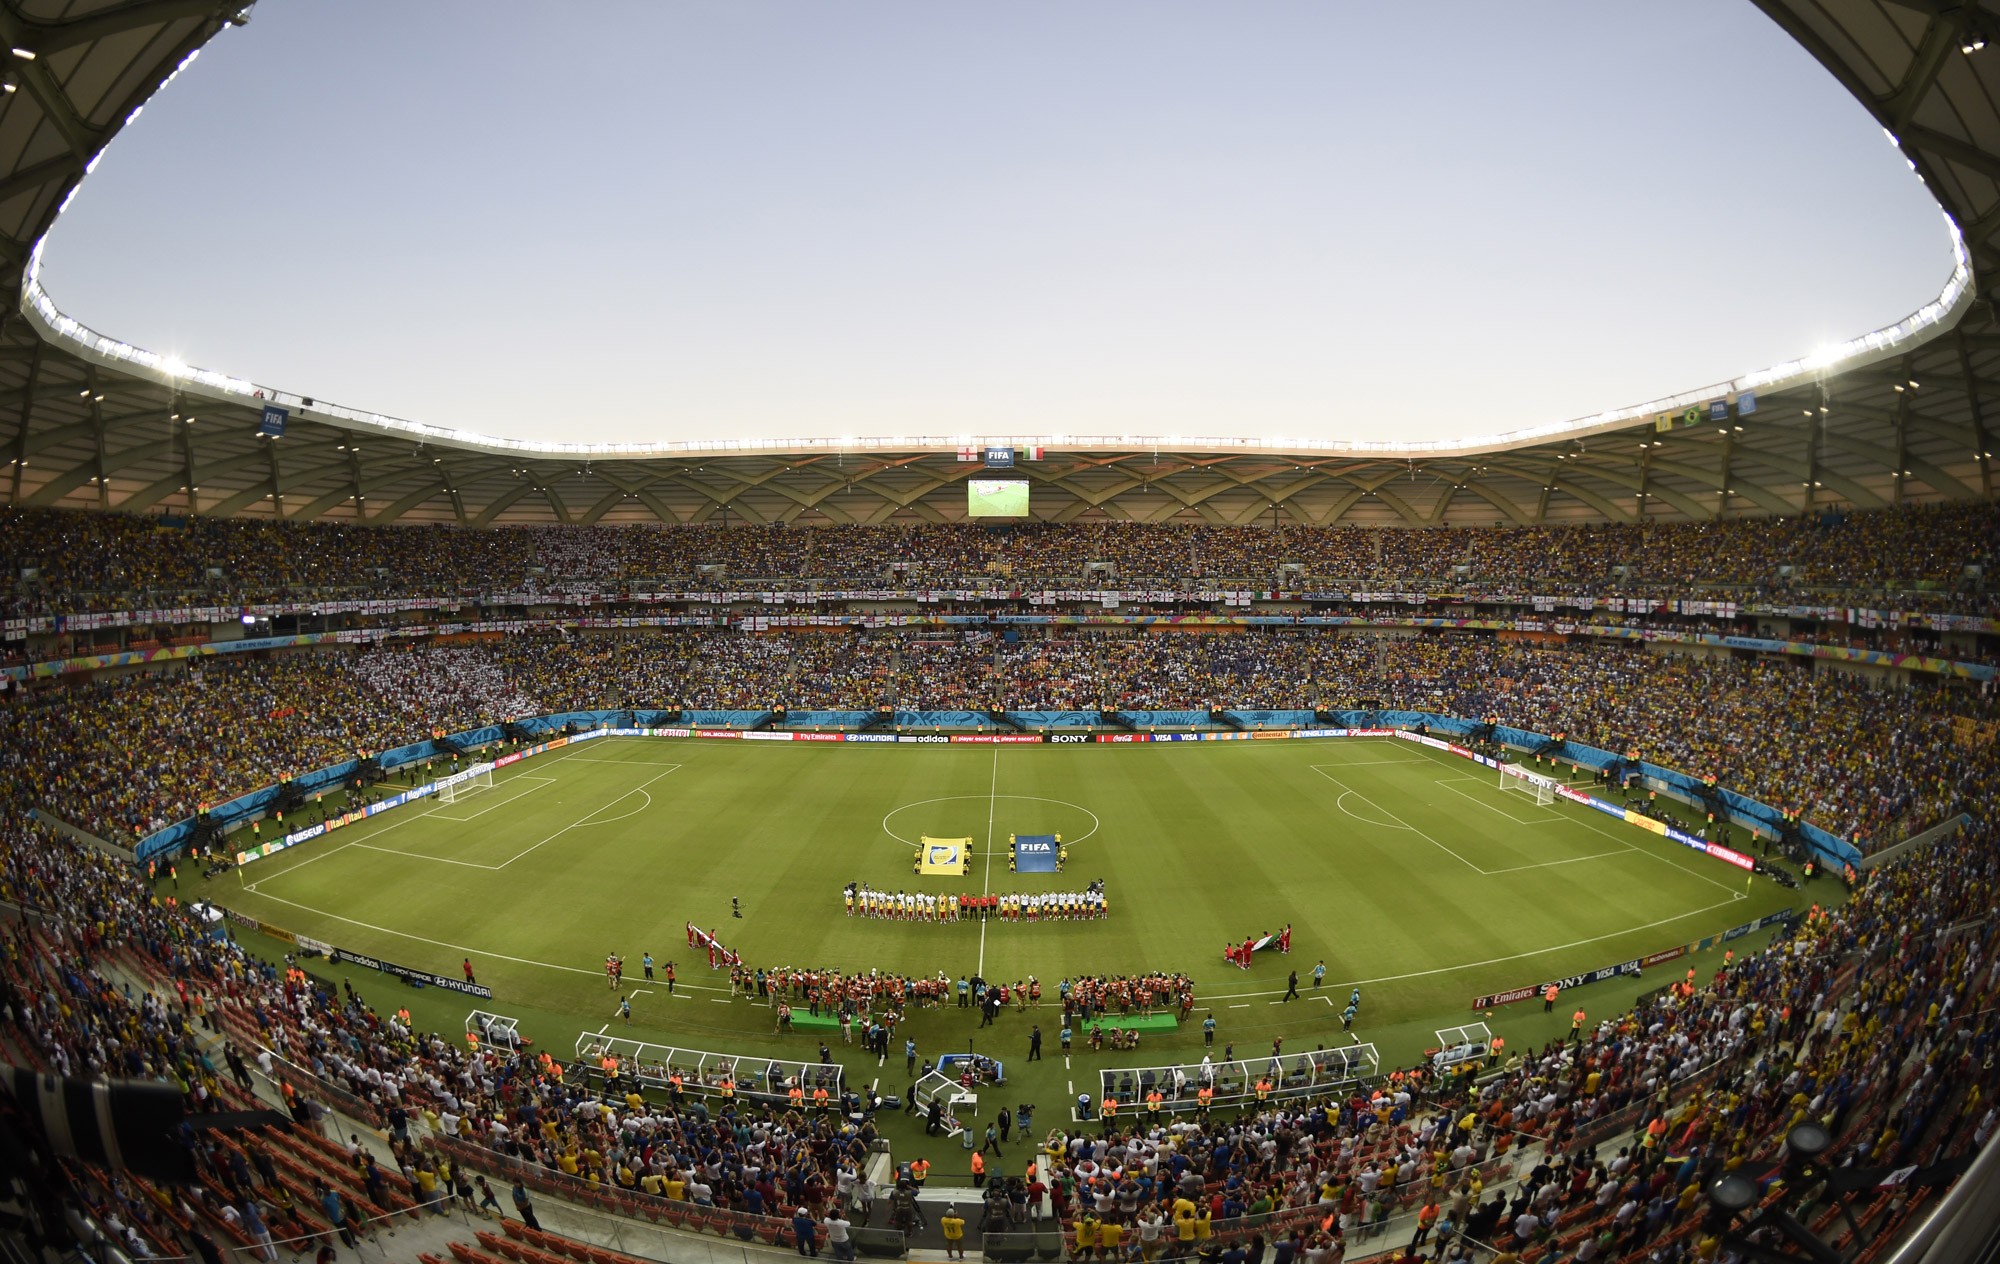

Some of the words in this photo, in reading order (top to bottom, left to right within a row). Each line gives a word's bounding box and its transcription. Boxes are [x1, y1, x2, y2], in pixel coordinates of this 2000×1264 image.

[265, 412, 282, 425] FIFA
[988, 451, 1009, 459] FIFA
[1252, 731, 1283, 739] Continental
[1349, 728, 1393, 736] Budweiser
[447, 773, 468, 786] adidas
[1528, 774, 1552, 789] SONY
[1671, 830, 1687, 845] Liberty
[1020, 843, 1050, 851] FIFA
[354, 956, 380, 970] adidas
[1619, 960, 1638, 974] VISA
[1594, 967, 1615, 980] VISA
[448, 981, 491, 998] HYUNDAI
[1494, 988, 1533, 1004] Emirates
